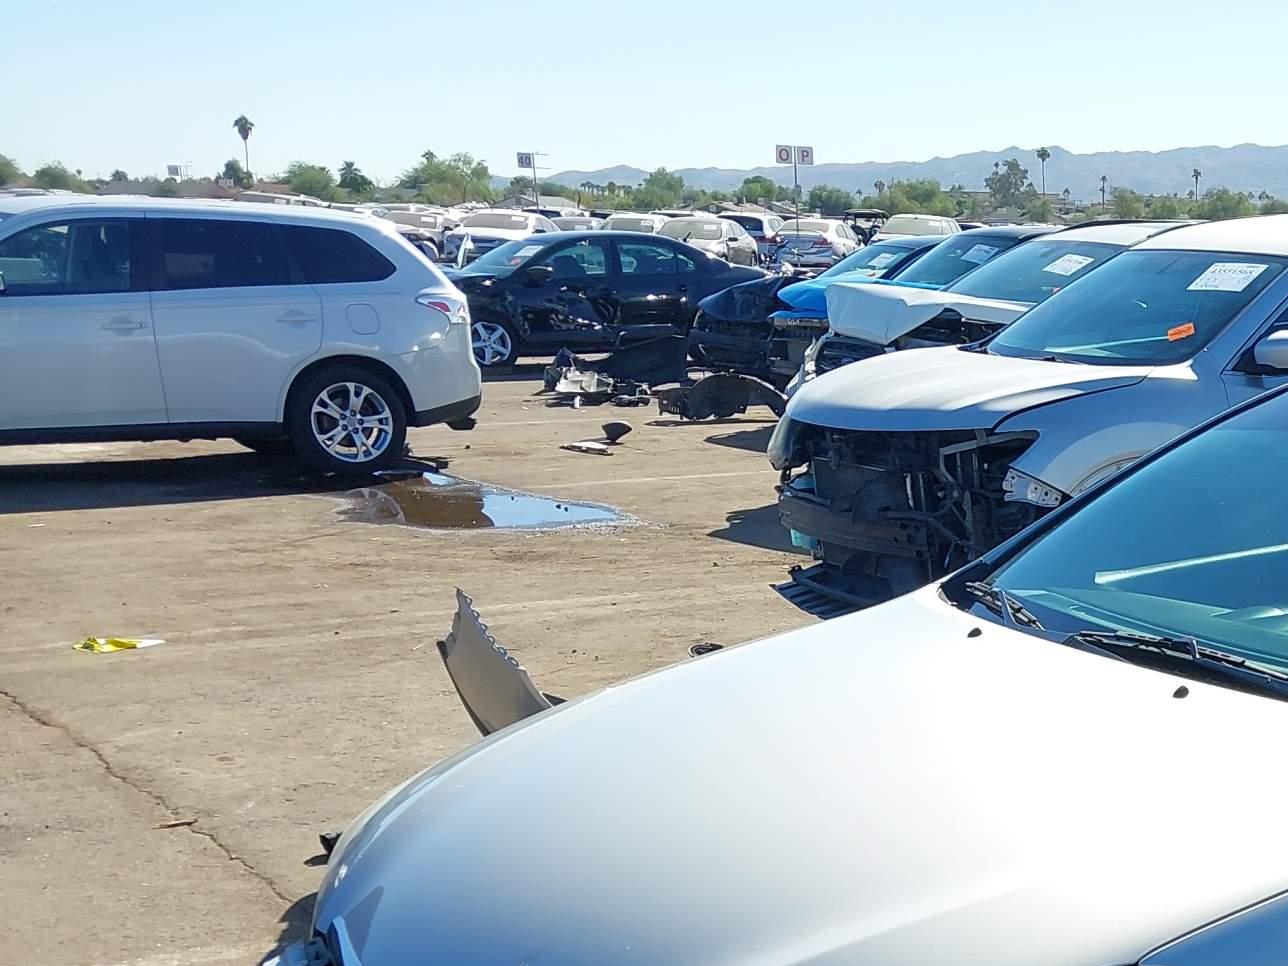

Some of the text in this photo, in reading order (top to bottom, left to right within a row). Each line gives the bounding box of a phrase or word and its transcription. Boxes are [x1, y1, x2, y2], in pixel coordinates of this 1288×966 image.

[779, 148, 789, 161] O
[802, 150, 809, 162] P
[518, 156, 531, 166] 40
